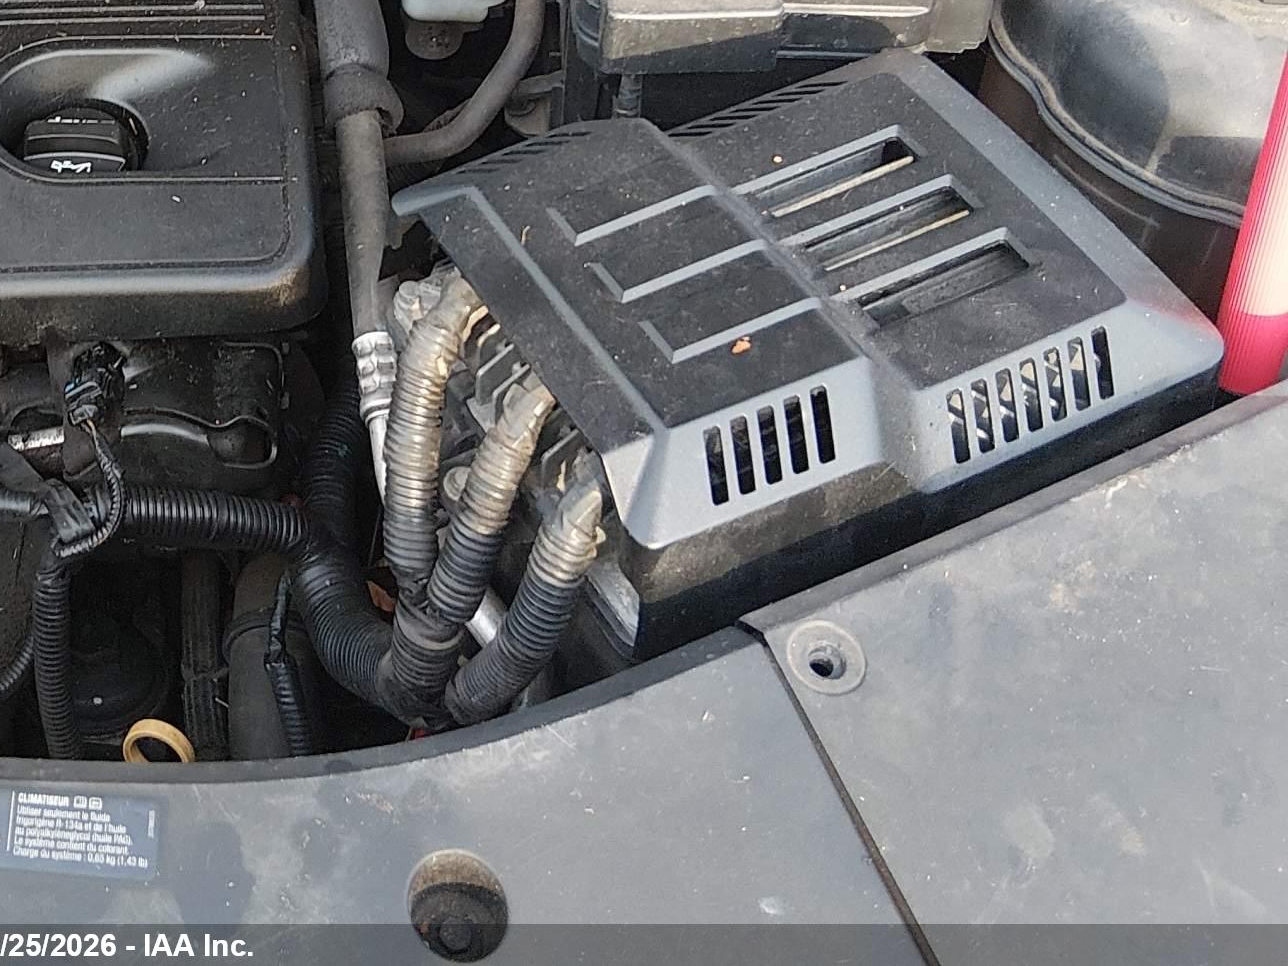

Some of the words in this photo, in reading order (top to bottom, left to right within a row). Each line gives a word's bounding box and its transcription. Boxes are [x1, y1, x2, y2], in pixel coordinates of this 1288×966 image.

[17, 792, 69, 807] CLIMATISEUR
[43, 807, 81, 820] seulement
[81, 811, 89, 820] le
[90, 811, 111, 822] fluide
[56, 818, 83, 830] R-134a
[93, 822, 103, 832] de
[14, 836, 24, 845] Le
[56, 840, 86, 851] contient
[86, 842, 97, 852] du
[13, 845, 39, 858] Charge
[40, 848, 50, 858] du
[51, 849, 82, 862] système
[105, 854, 116, 866] kg
